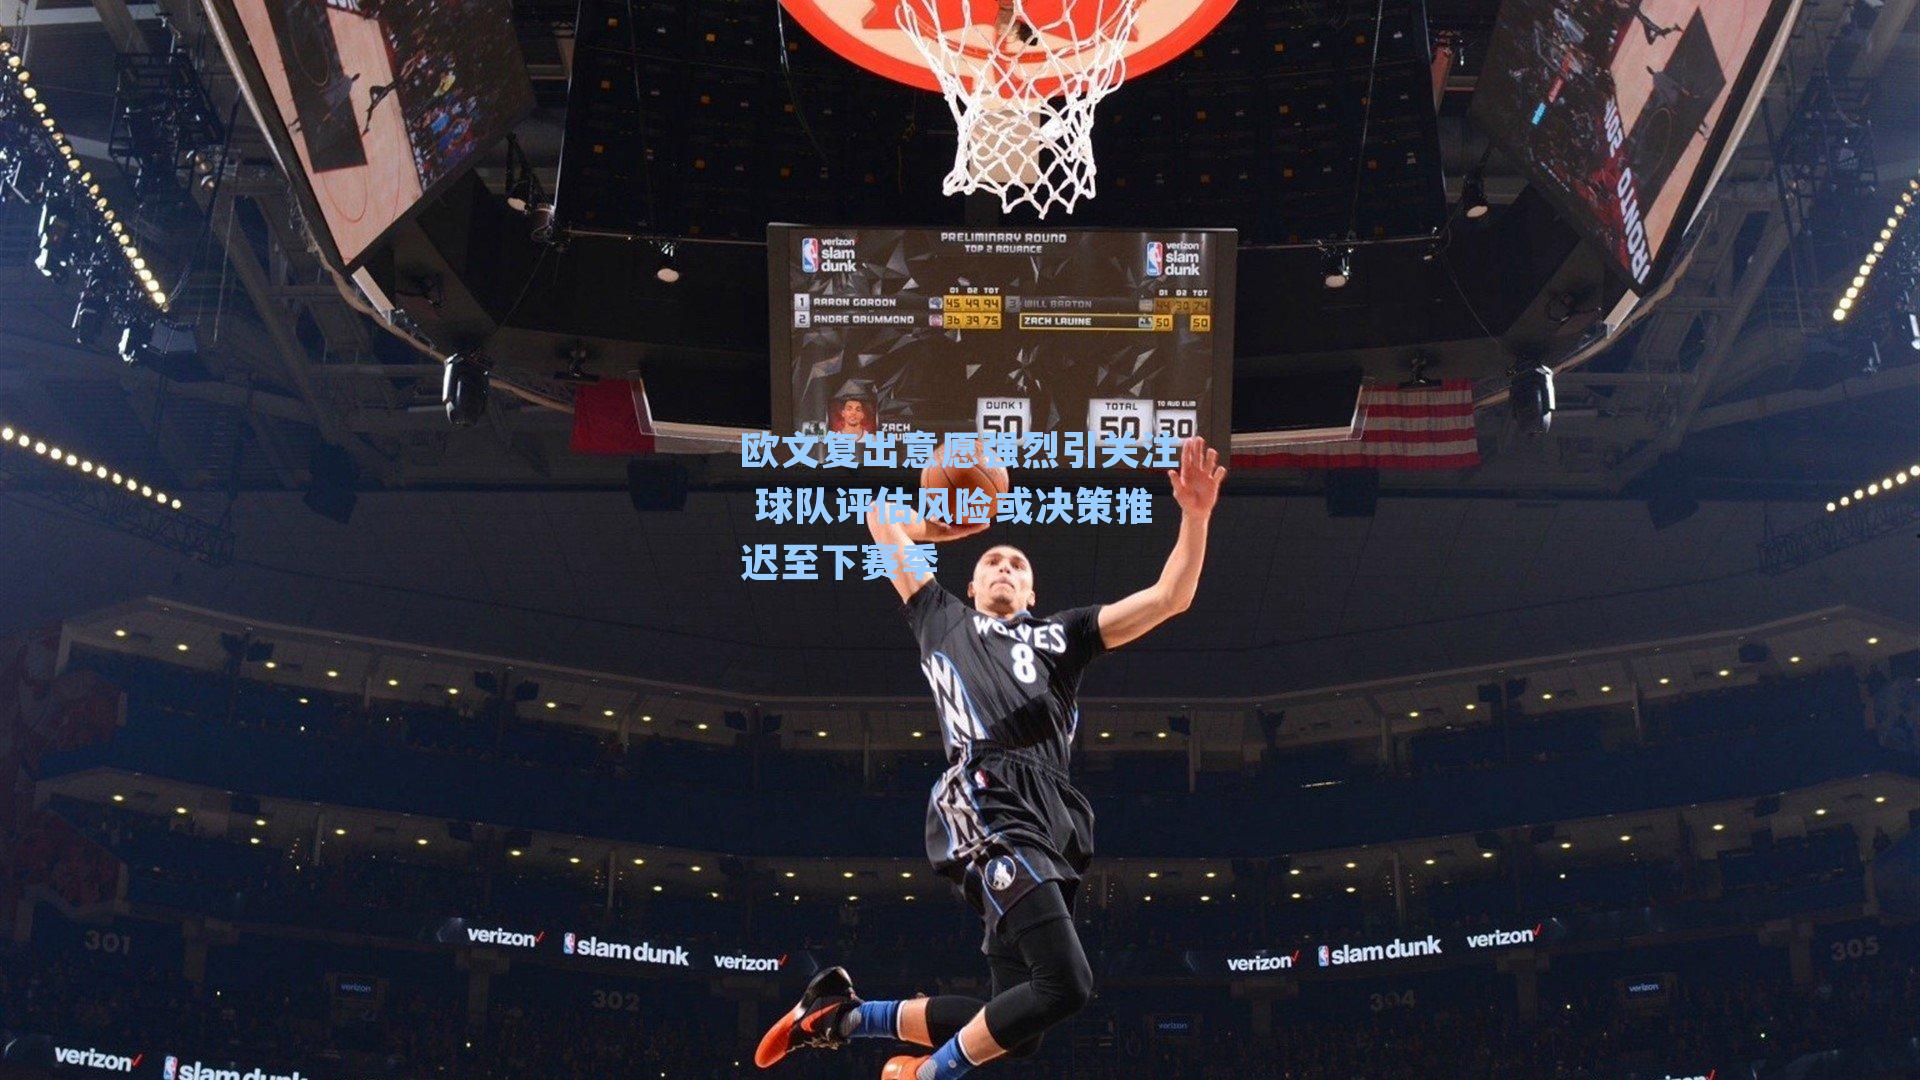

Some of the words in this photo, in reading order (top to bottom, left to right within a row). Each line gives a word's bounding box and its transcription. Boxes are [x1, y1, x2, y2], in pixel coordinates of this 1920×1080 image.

[1617, 167, 1650, 284] RONTO
[821, 238, 854, 246] verizon
[940, 232, 1021, 243] PRELIMINARY
[1025, 233, 1067, 244] ROUND
[965, 245, 984, 254] TOP
[986, 245, 994, 253] 2
[1165, 242, 1200, 250] verizon
[821, 247, 855, 260] slam
[1165, 251, 1200, 263] slam
[821, 260, 857, 272] dunk
[1165, 264, 1200, 276] dunk
[813, 298, 850, 307] AARON
[852, 298, 897, 307] GORDON
[946, 298, 960, 308] 45
[966, 298, 980, 308] 49
[984, 298, 999, 308] 94
[798, 314, 806, 324] 2
[813, 315, 849, 324] ANDRE
[852, 315, 914, 324] DRUMMOND
[966, 316, 980, 325] 39
[984, 316, 999, 325] 75
[1024, 316, 1052, 326] ZACH
[1156, 318, 1170, 327] 50
[1193, 318, 1208, 328] 50
[986, 401, 1015, 410] DUNK
[1105, 402, 1138, 411] TOTAL
[881, 423, 911, 432] ZACH
[983, 415, 1023, 440] 50
[1100, 416, 1140, 441] 50
[1159, 418, 1193, 439] 30
[973, 616, 1067, 654] WOLVES
[1010, 642, 1038, 684] 8
[467, 927, 536, 948] verizon
[1466, 929, 1534, 948] verizon
[576, 936, 631, 960] slam
[632, 941, 690, 966] dunk
[1331, 944, 1384, 965] slam
[1385, 935, 1443, 959] dunk
[714, 954, 779, 971] verizon
[1227, 955, 1292, 971] verizon
[1628, 982, 1660, 993] verizon
[54, 1046, 132, 1072] verizon
